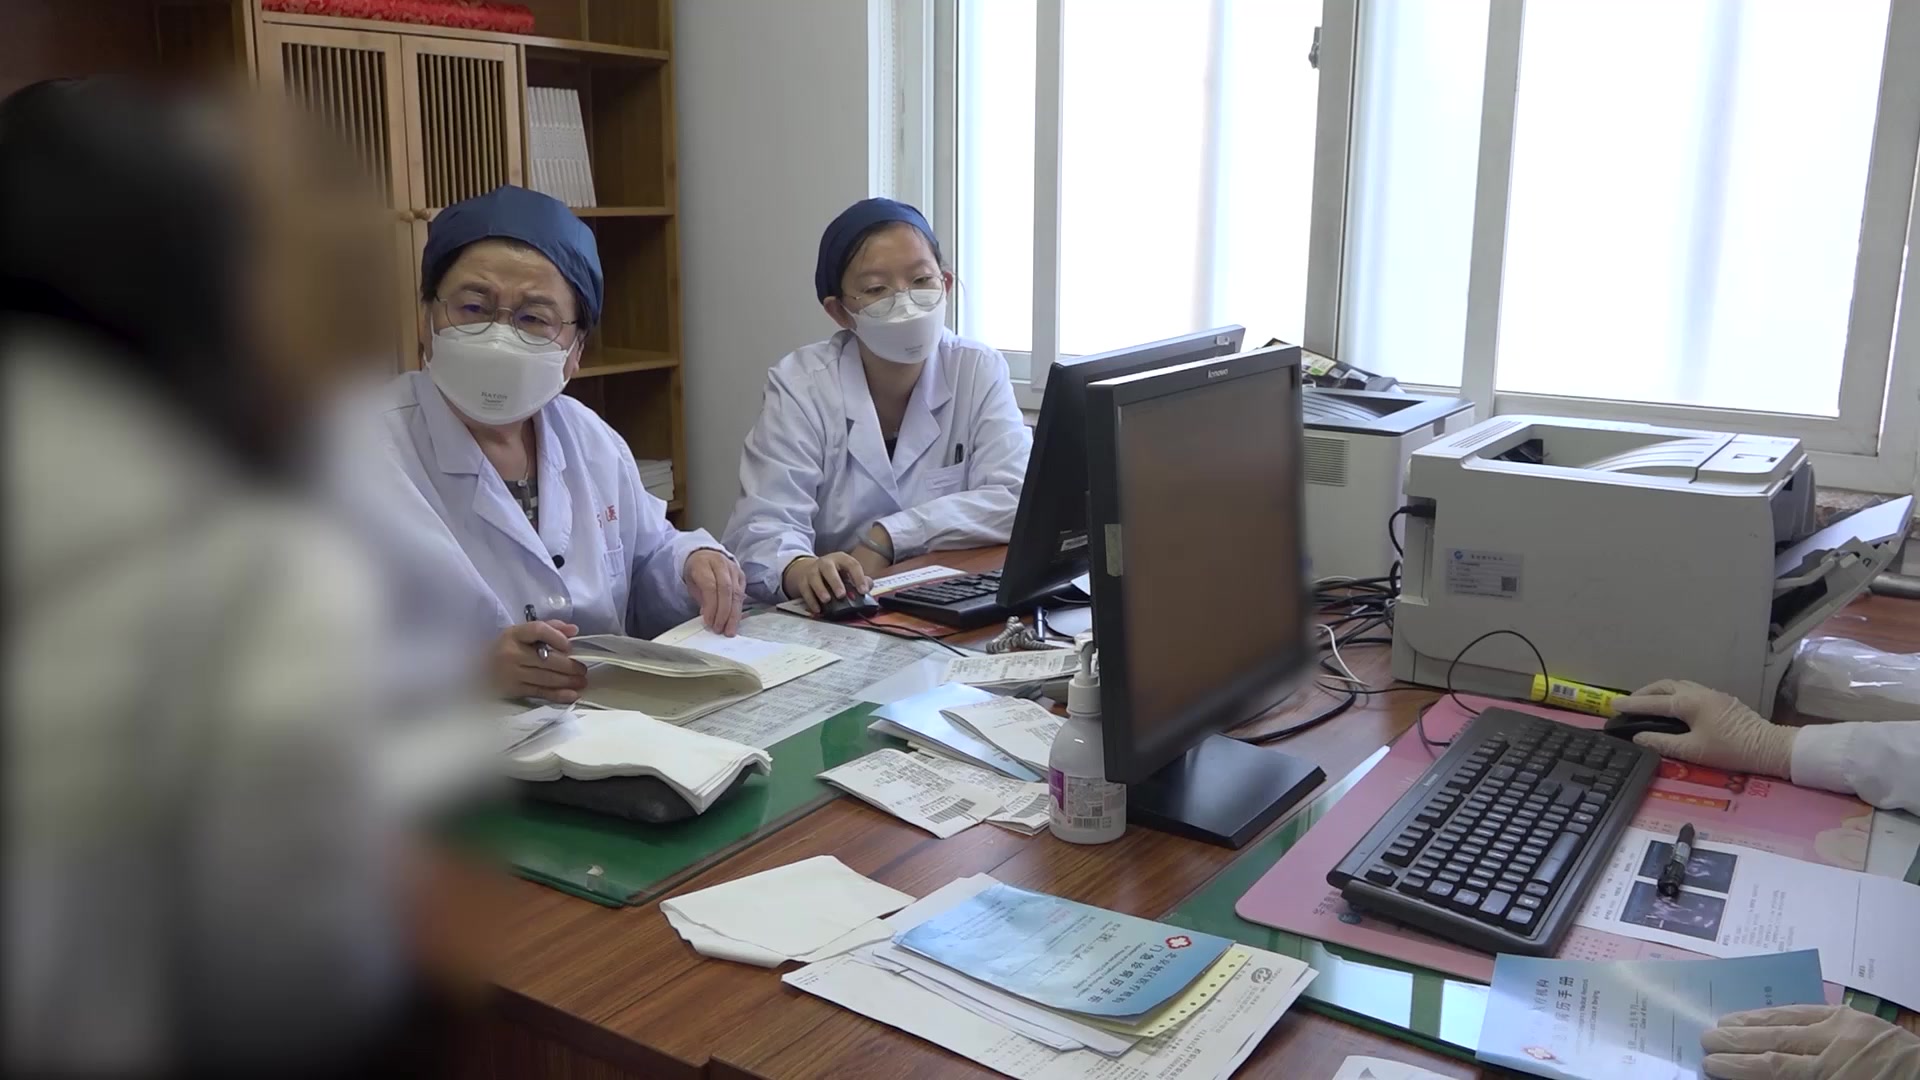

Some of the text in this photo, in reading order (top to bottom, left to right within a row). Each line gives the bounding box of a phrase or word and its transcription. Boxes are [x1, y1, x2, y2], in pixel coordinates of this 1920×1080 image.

[1087, 944, 1165, 1003] 门急诊病历手册
